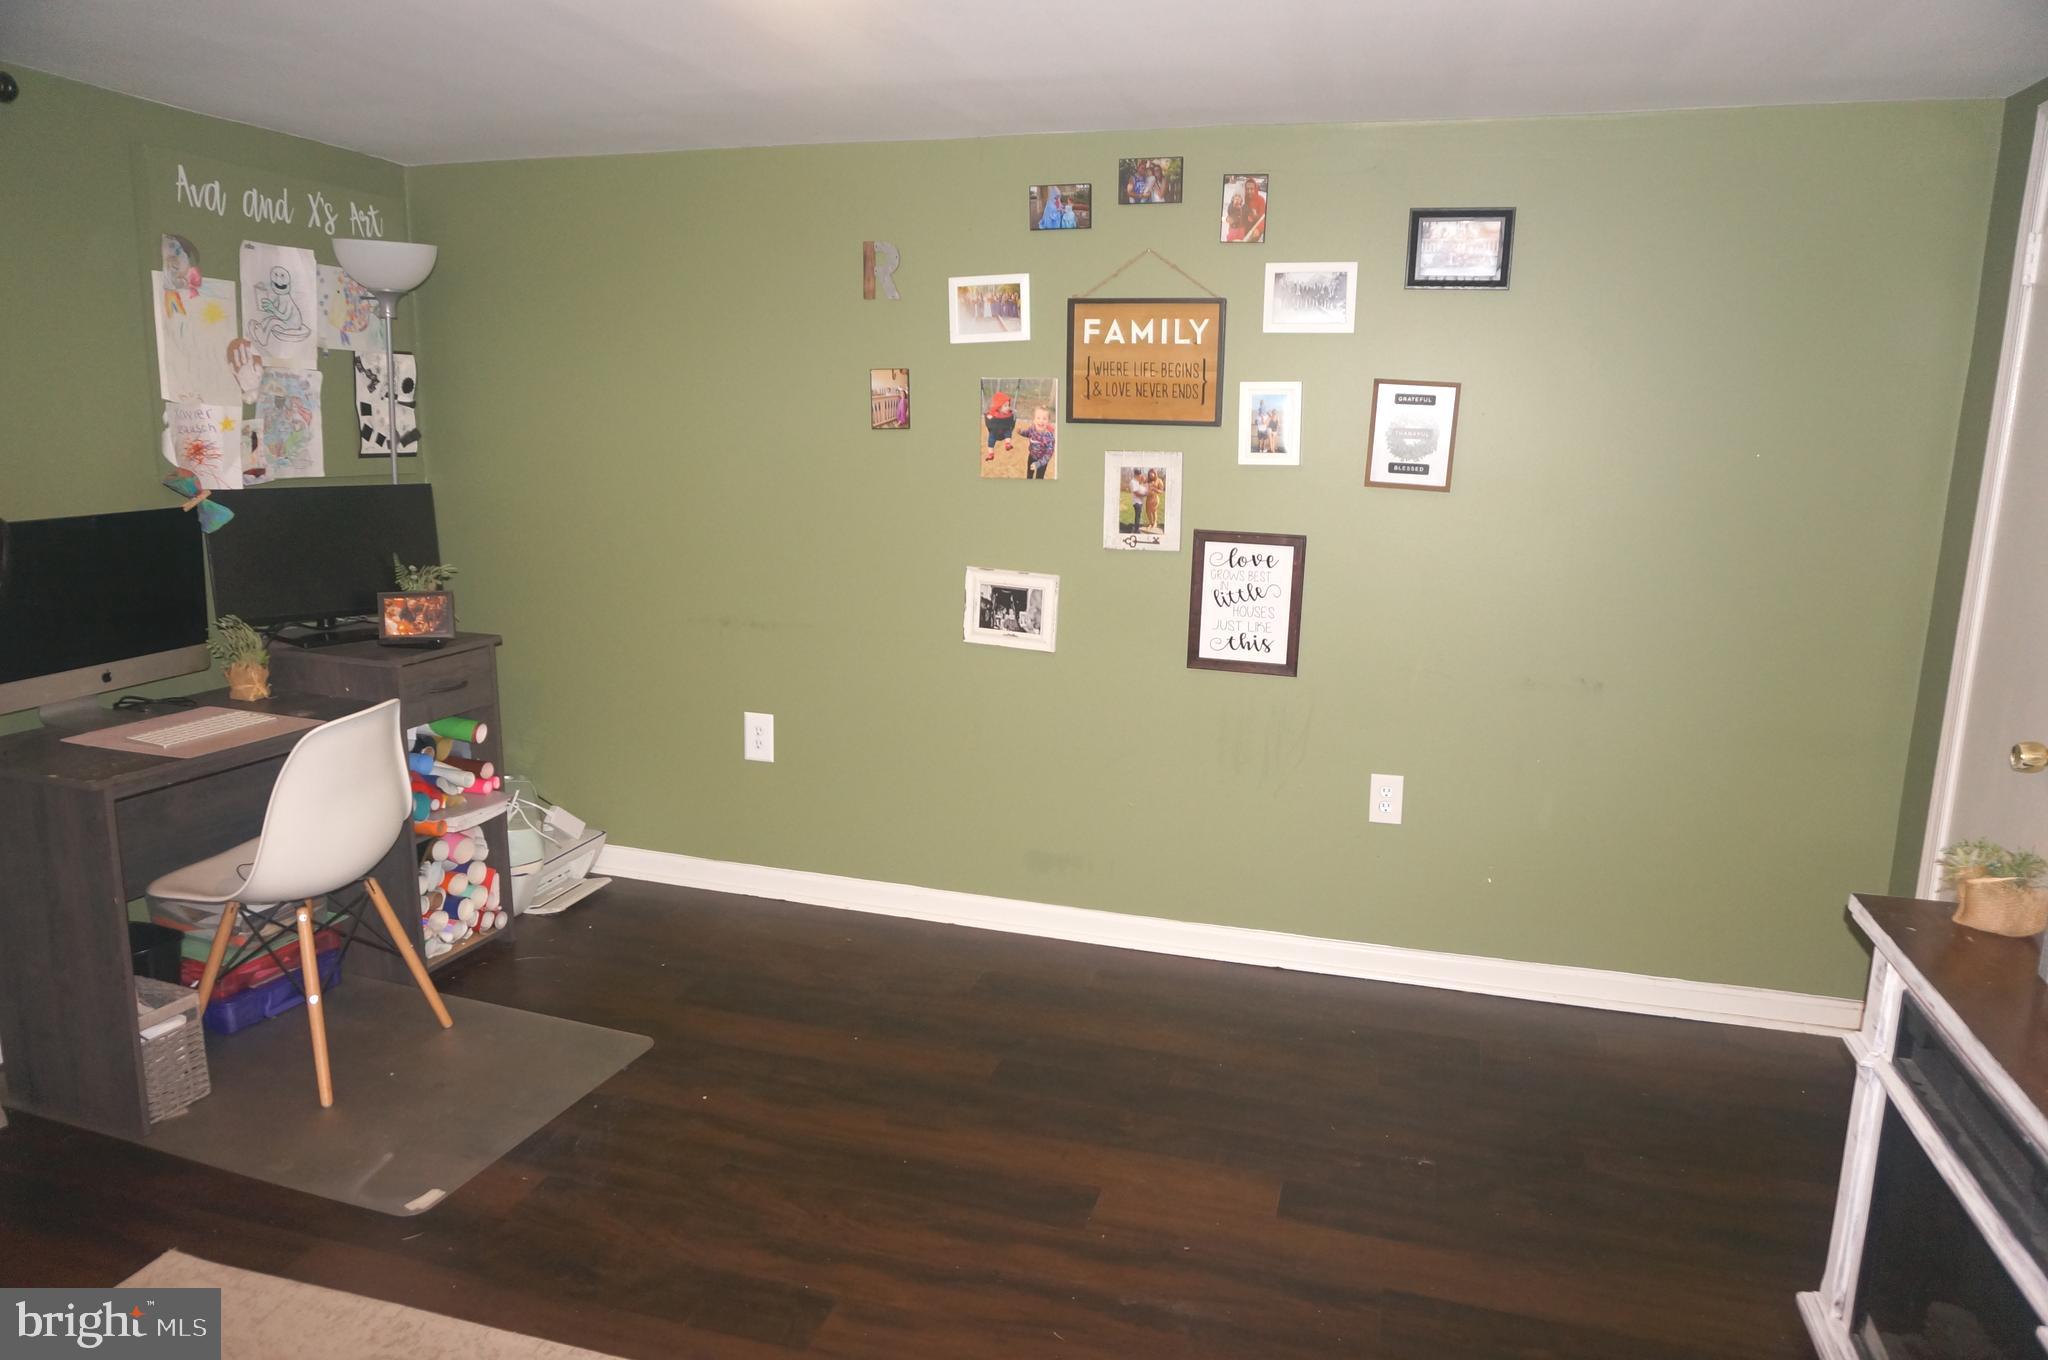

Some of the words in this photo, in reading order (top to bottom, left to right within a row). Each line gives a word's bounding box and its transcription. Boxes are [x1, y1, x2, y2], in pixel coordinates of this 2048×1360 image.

[176, 164, 227, 217] Ava
[243, 188, 294, 224] and
[308, 191, 338, 235] X's
[350, 201, 383, 238] Art
[1083, 318, 1210, 345] FAMILY
[1093, 361, 1129, 377] WHERE
[1134, 362, 1158, 378] LIFE
[1161, 362, 1200, 379] BEGINS
[1092, 381, 1102, 396] &
[1106, 382, 1131, 398] LOVE
[1136, 382, 1168, 398] NEVER
[1172, 383, 1199, 399] ENDS
[1398, 396, 1432, 404] GRATEFUL
[1393, 465, 1424, 473] BLESSED
[1209, 547, 1279, 568] love
[1210, 569, 1245, 582] GROWS
[1248, 571, 1272, 583] BEST
[1220, 581, 1229, 591] IN
[1213, 583, 1281, 608] little
[1232, 606, 1275, 619] HOUSES
[1212, 620, 1241, 632] JUST
[1248, 621, 1272, 634] LIKE
[1209, 632, 1275, 653] this
